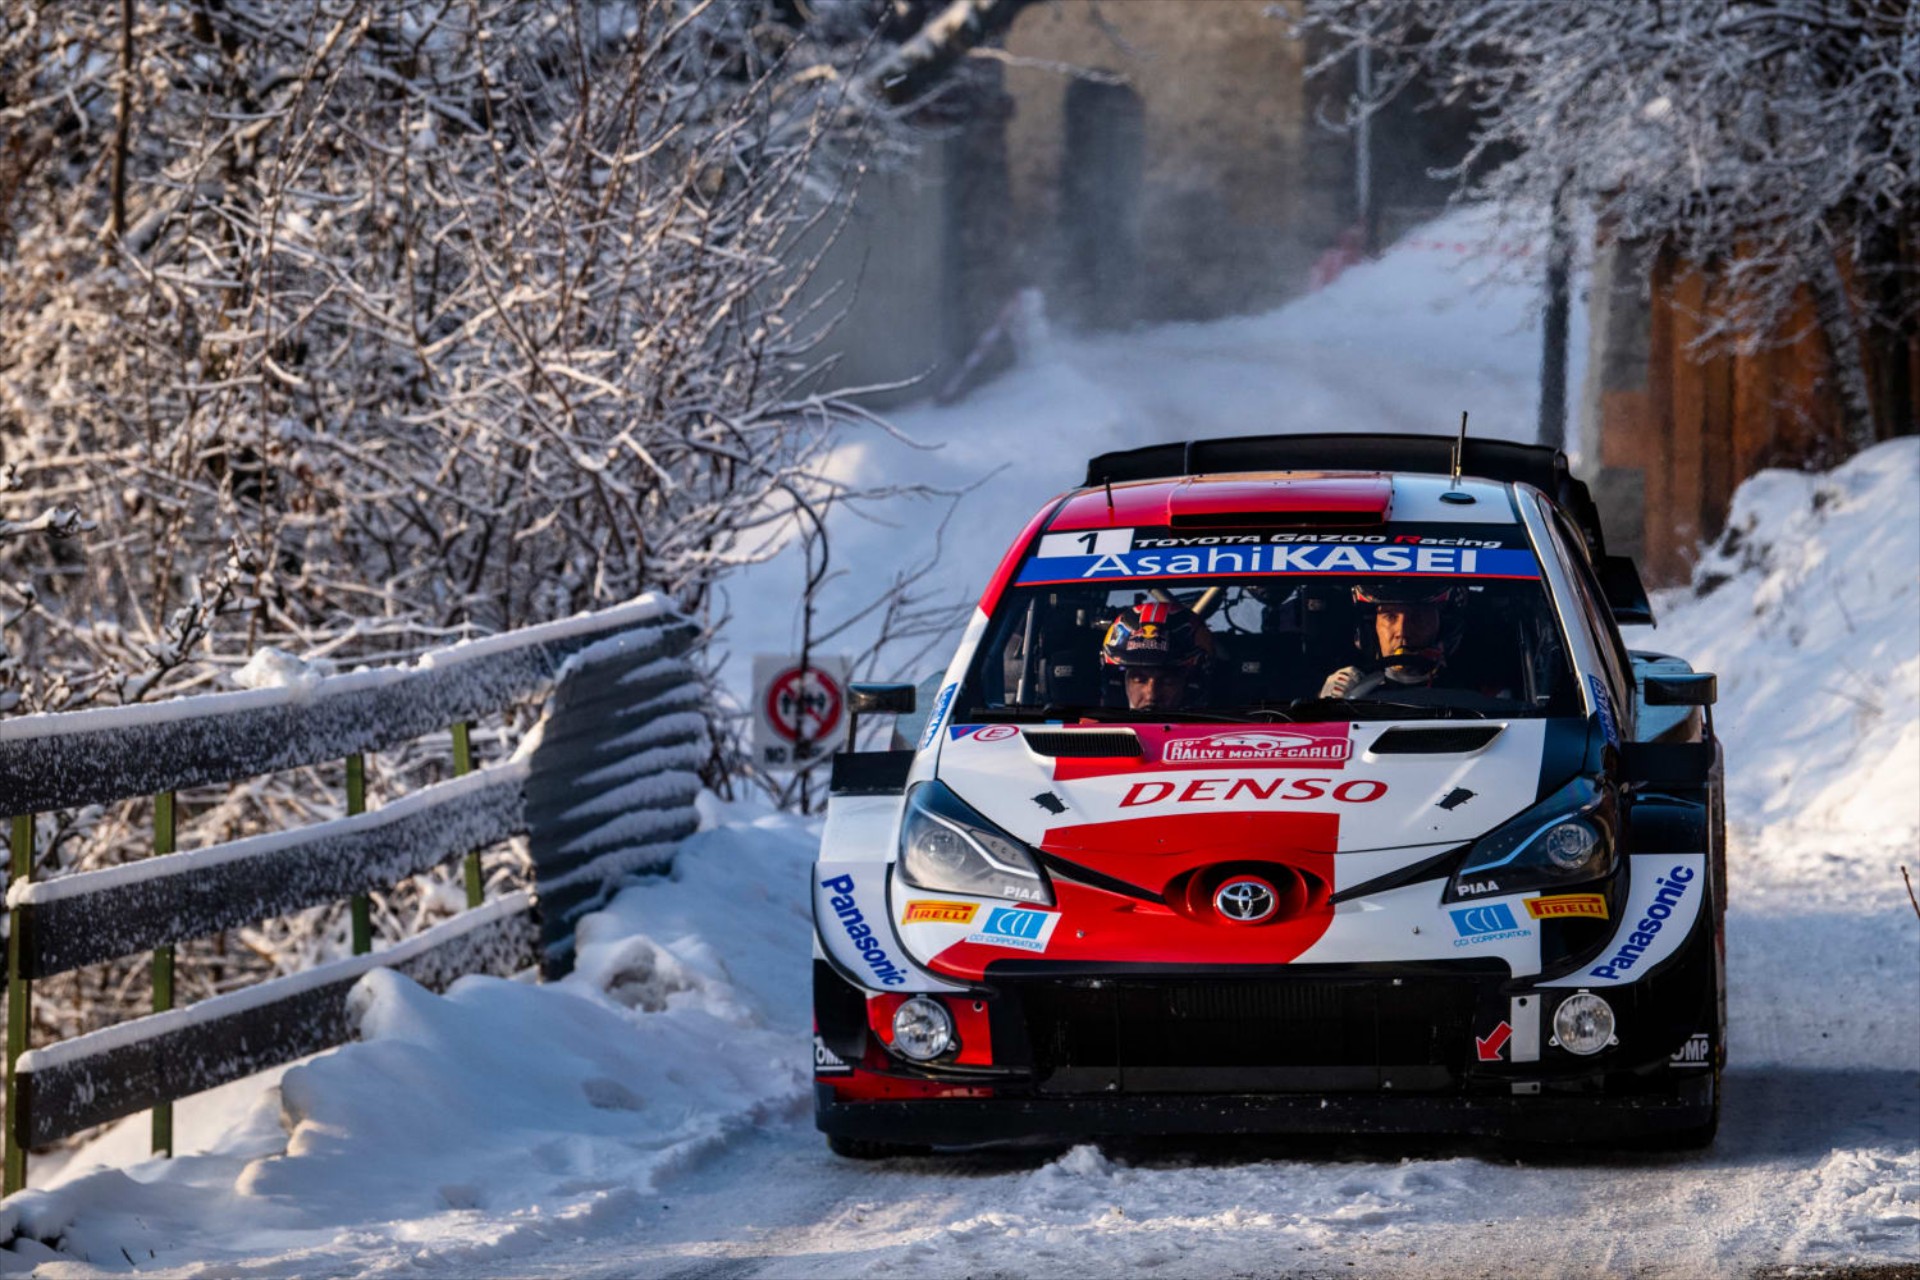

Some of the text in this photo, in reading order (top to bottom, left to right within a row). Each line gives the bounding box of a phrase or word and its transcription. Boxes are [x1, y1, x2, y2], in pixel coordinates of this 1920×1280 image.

[1077, 532, 1099, 554] 1
[1134, 533, 1502, 549] TOYOTA GAZOO Racing
[1171, 745, 1343, 760] RALLYE MONTE-CARLO
[1119, 778, 1389, 808] DENSO
[1003, 885, 1042, 900] PIAA
[1457, 880, 1500, 897] PIAA
[907, 903, 973, 921] PIRELLI
[1531, 897, 1604, 916] PIRELLI
[821, 873, 908, 987] Panasonic
[1590, 865, 1694, 980] Panasonic
[984, 935, 1044, 950] CORPORATION
[1471, 929, 1532, 944] CORPORATION
